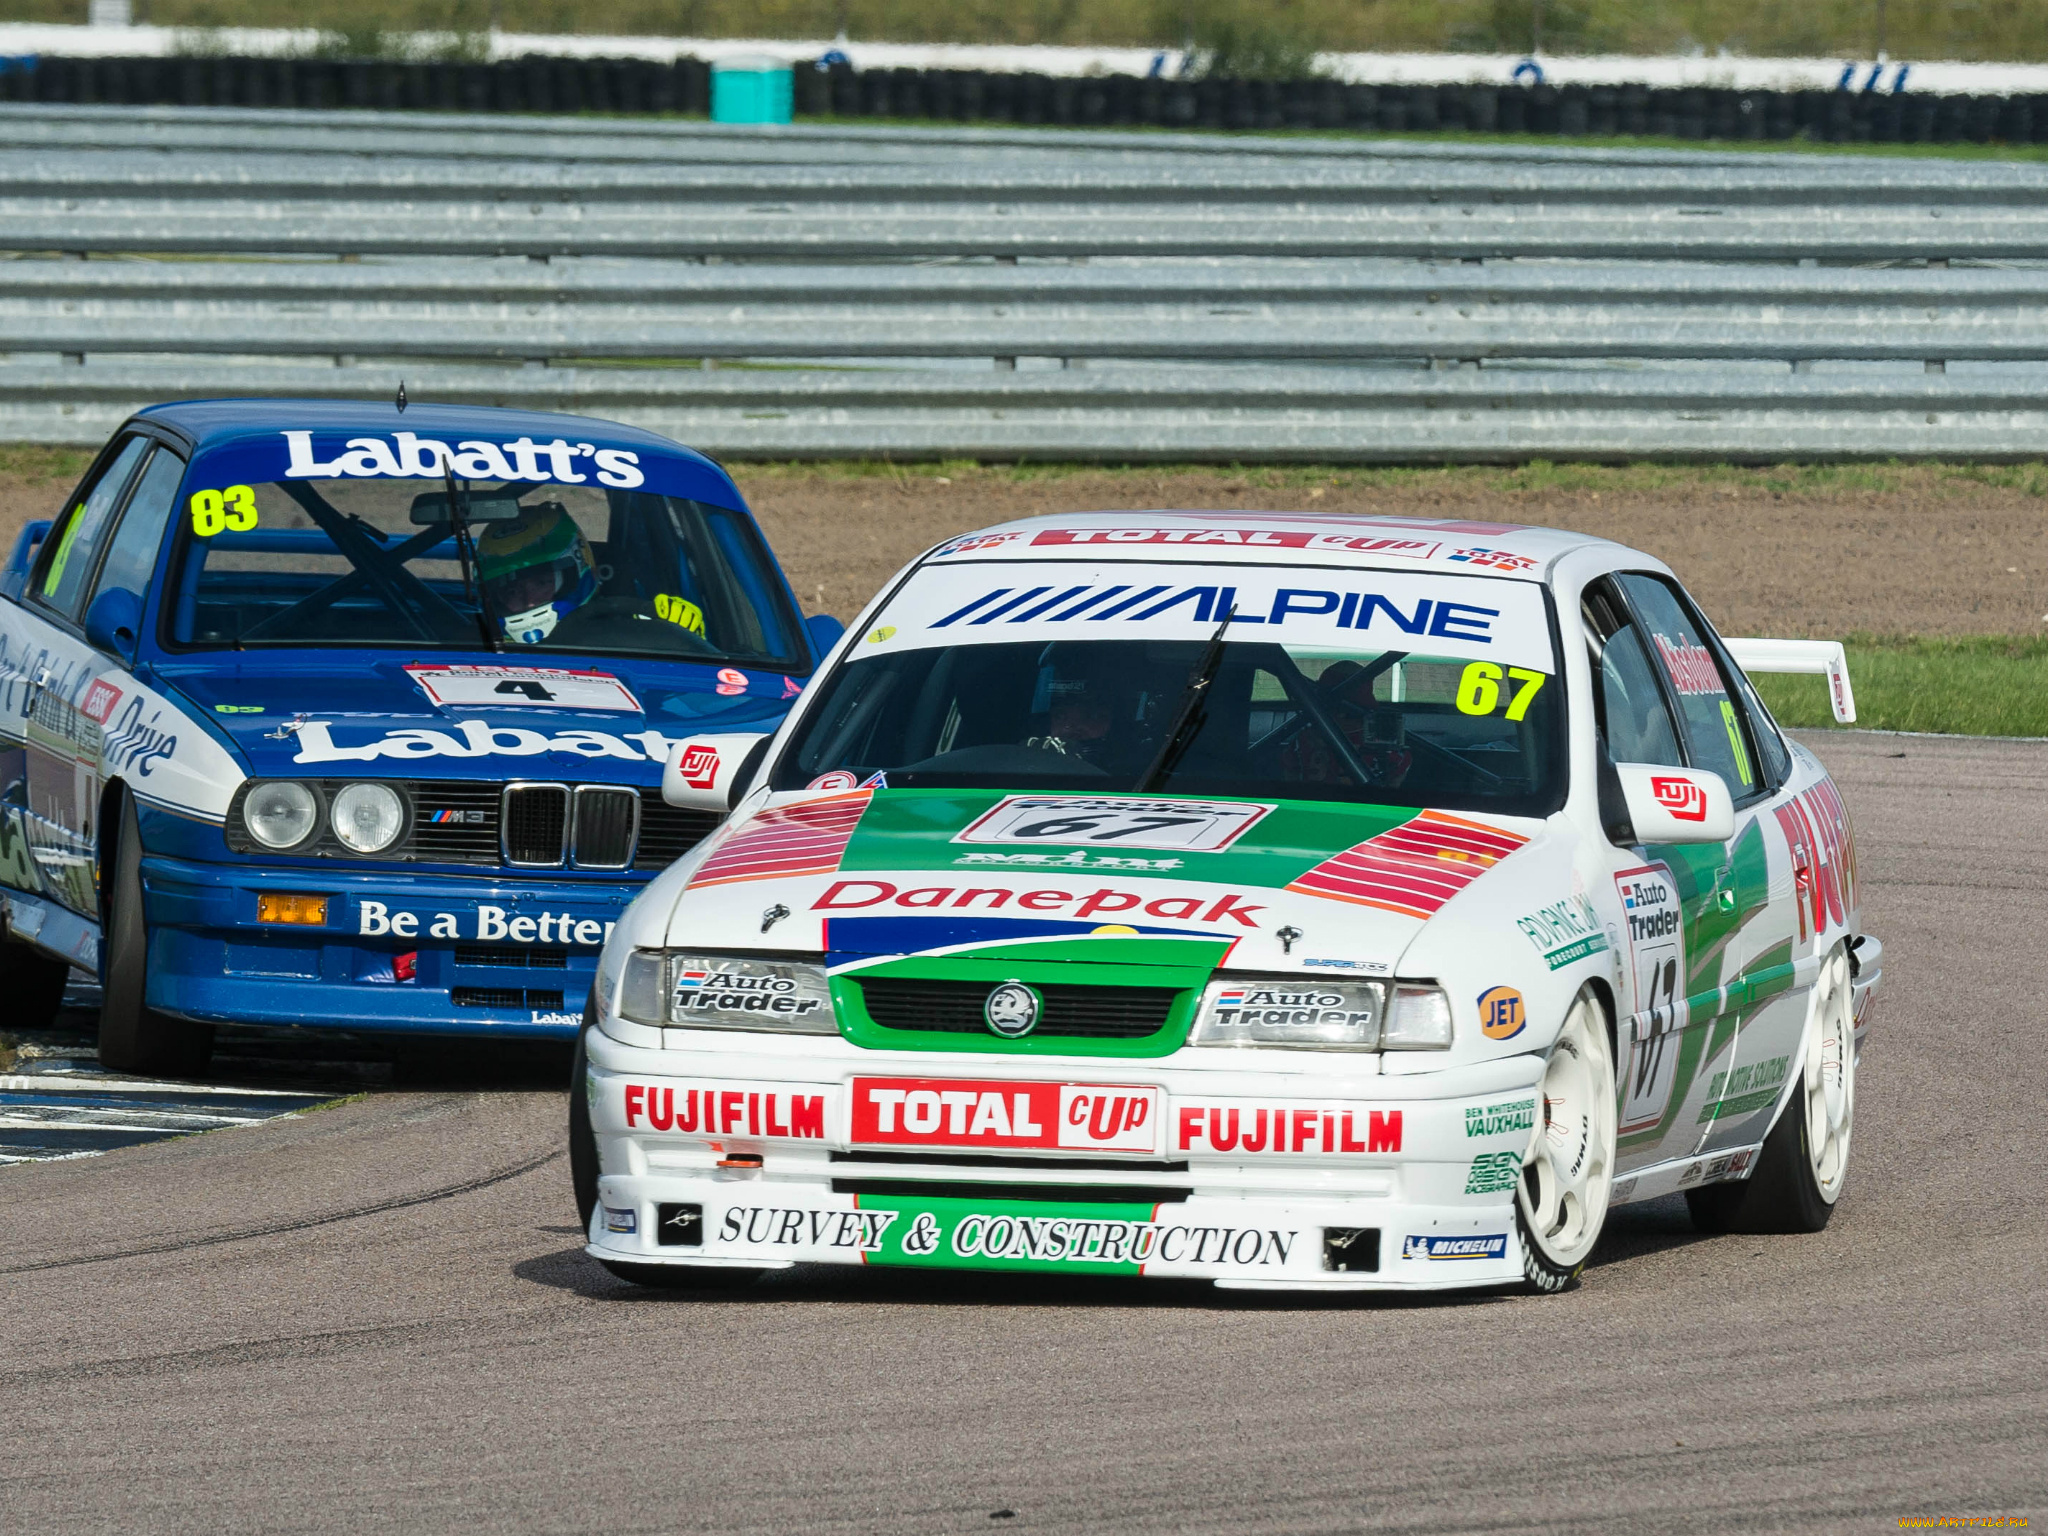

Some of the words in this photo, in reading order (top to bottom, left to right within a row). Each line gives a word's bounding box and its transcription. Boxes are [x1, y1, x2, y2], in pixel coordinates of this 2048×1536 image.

[280, 430, 645, 489] Labatt's
[190, 485, 259, 538] 83
[1064, 529, 1283, 546] TOTAL
[1455, 549, 1535, 571] TOTAL
[1123, 586, 1500, 644] ALPINE
[493, 680, 557, 701] 4
[1456, 661, 1546, 722] 67
[104, 695, 178, 778] Drive
[281, 720, 680, 764] Labat
[679, 744, 721, 790] FUJI
[447, 810, 484, 823] M3
[1650, 776, 1707, 822] FUJI
[1012, 814, 1207, 840] 67
[808, 879, 1270, 929] Danepak
[1632, 881, 1667, 908] Auto
[359, 900, 419, 938] Be
[429, 912, 460, 939] a
[1628, 907, 1679, 942] Trader
[704, 973, 796, 992] Auto
[1244, 990, 1343, 1007] Auto
[675, 990, 819, 1014] Trader
[1215, 1008, 1369, 1028] Trader
[1486, 997, 1519, 1028] JET
[625, 1084, 825, 1139] FUJIFILM
[868, 1088, 1043, 1137] TOTAL
[1179, 1106, 1402, 1154] FUJIFILM
[1465, 1107, 1483, 1118] BEN
[1465, 1111, 1534, 1137] VAUXHALL
[1570, 1115, 1588, 1177] DYMAG
[718, 1205, 896, 1249] SURVEY
[905, 1215, 939, 1252] &
[955, 1216, 1298, 1266] CONSTRUCTION
[1431, 1238, 1504, 1254] MICHELIN
